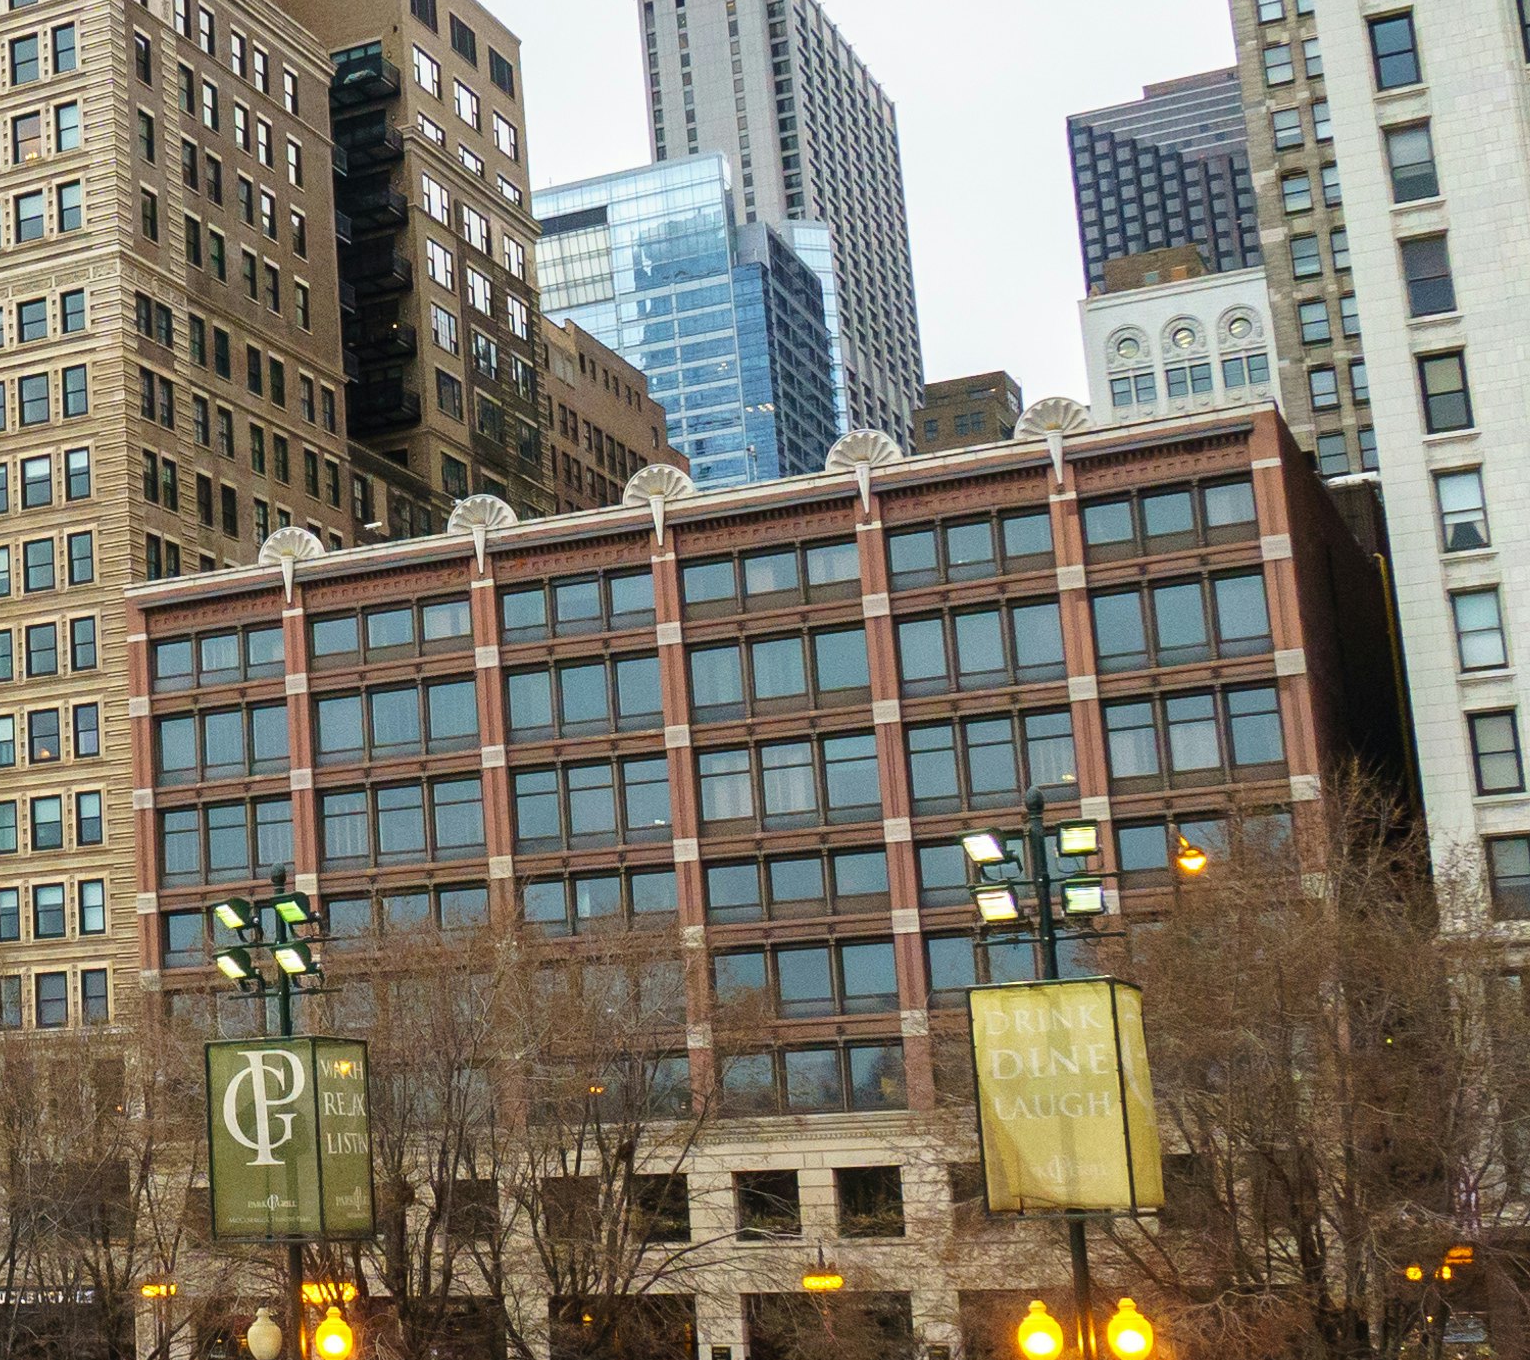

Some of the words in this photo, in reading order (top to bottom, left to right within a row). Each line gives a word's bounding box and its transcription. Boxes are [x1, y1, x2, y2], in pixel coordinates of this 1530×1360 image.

[984, 1004, 1105, 1036] DRINK
[989, 1043, 1110, 1080] DINE
[993, 1091, 1113, 1121] LAUGH
